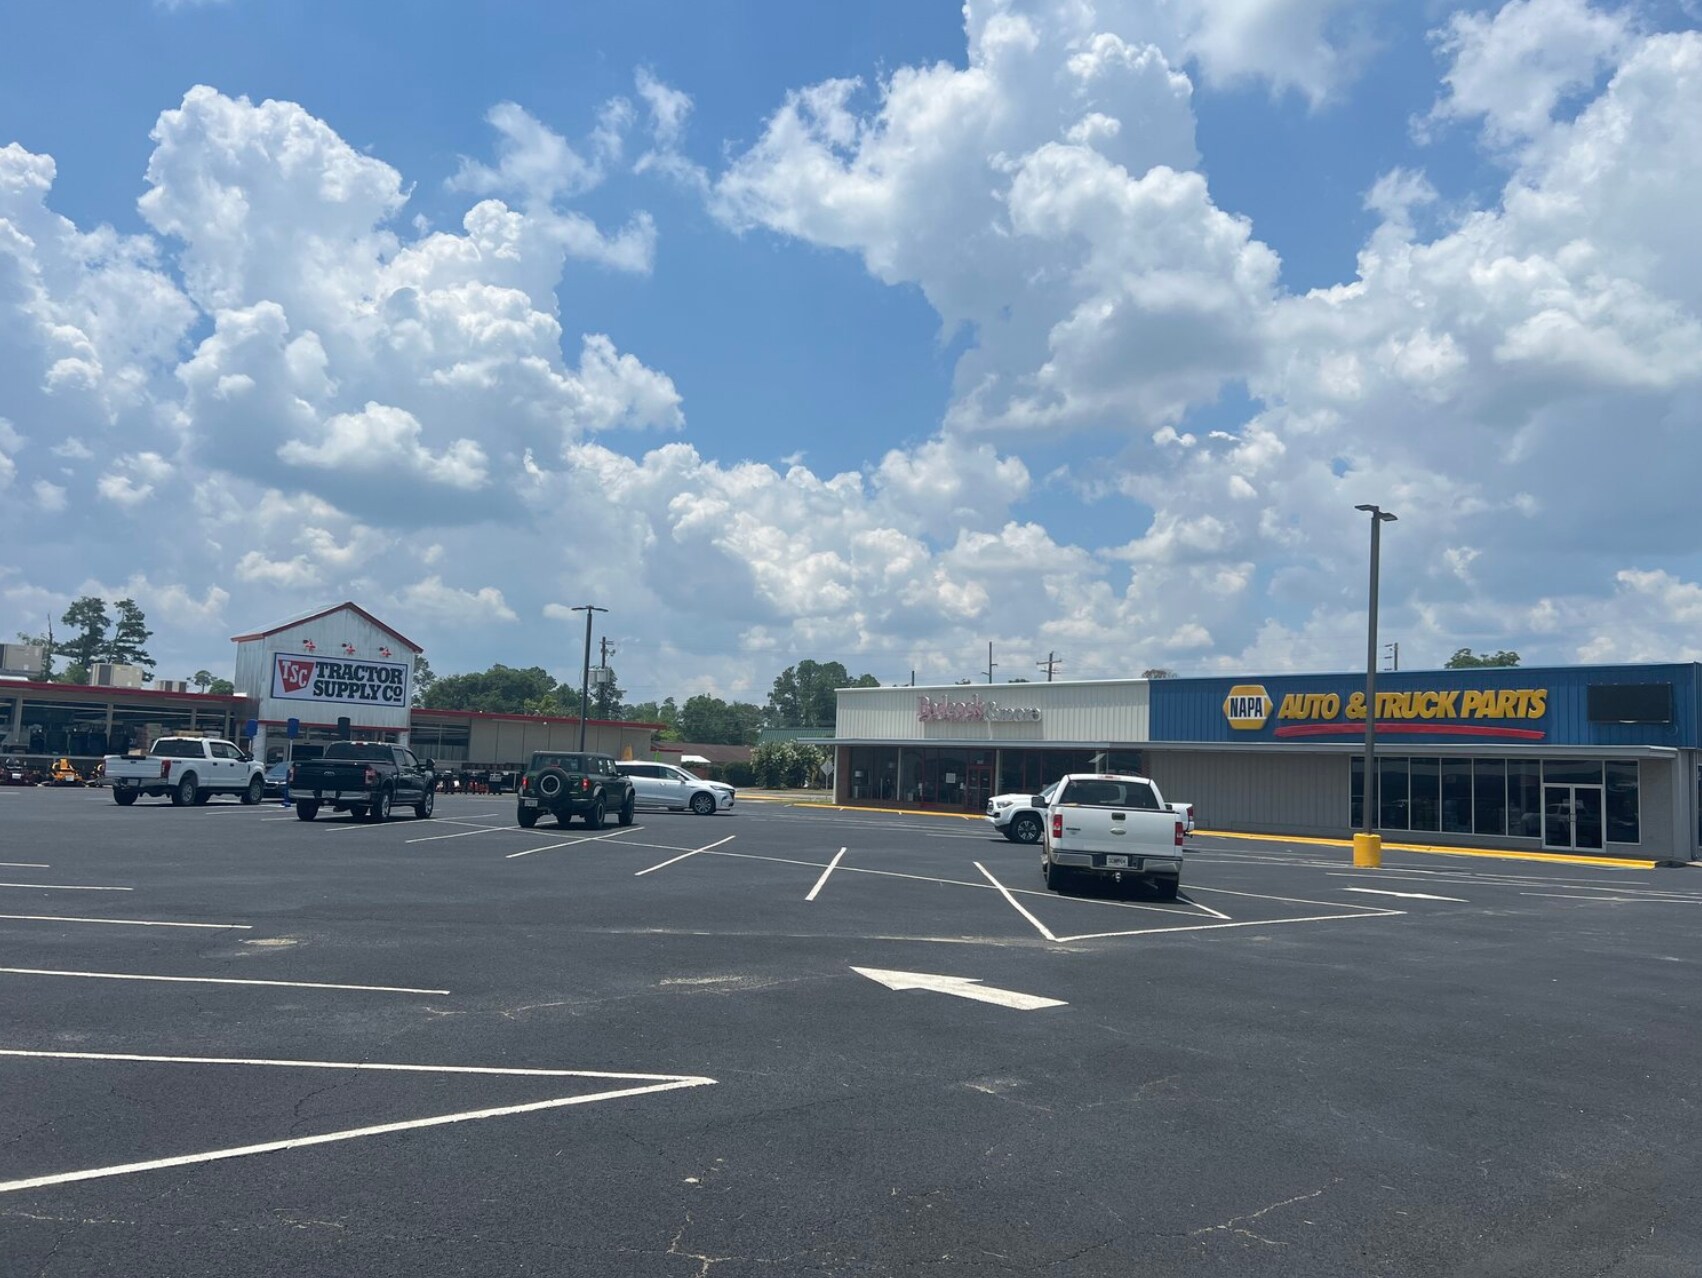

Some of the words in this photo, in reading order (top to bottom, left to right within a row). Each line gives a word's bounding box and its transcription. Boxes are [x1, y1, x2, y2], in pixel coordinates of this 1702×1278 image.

[282, 661, 308, 688] TSC
[315, 661, 403, 685] TRACTOR
[313, 681, 381, 701] SUPPLY
[1229, 696, 1263, 718] NAPA
[1277, 692, 1341, 720] AUTO
[1345, 691, 1367, 720] &
[1374, 690, 1461, 719] TRUCK
[1460, 689, 1548, 719] PARTS
